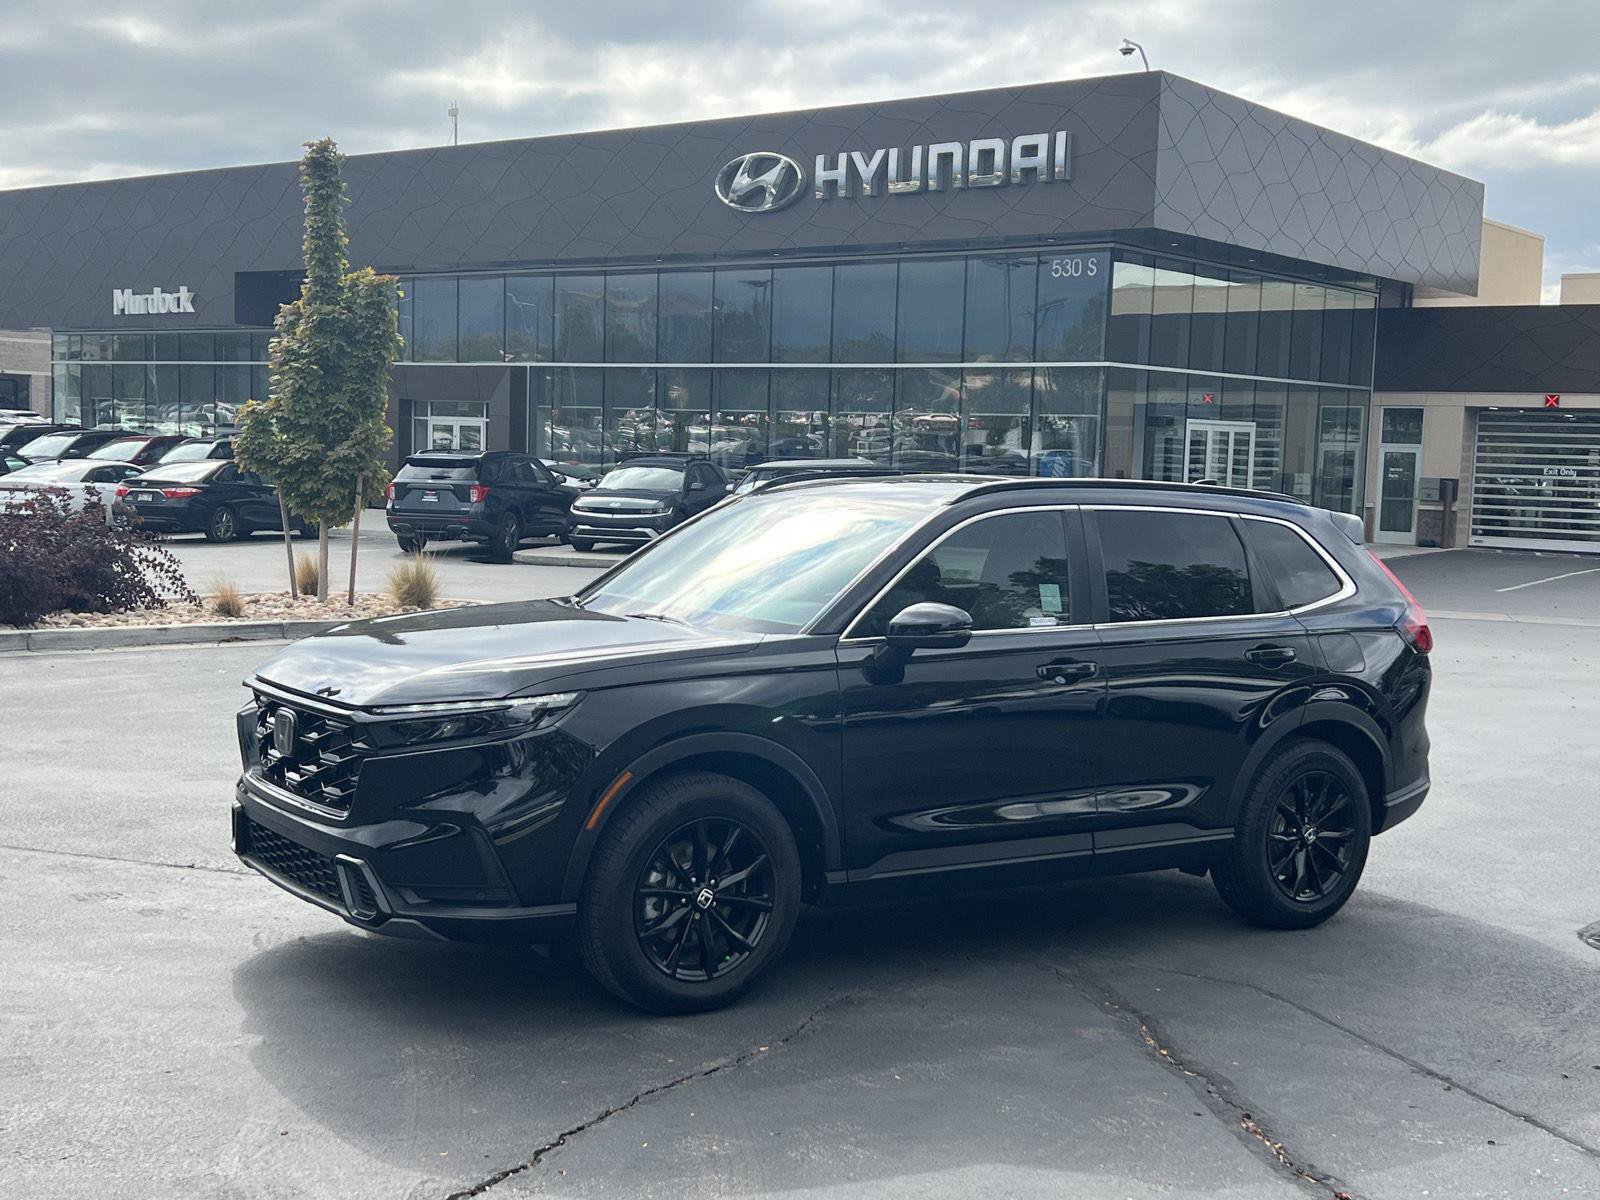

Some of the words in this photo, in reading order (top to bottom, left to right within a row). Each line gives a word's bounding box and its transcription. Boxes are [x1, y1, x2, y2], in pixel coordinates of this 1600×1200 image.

[814, 130, 1072, 199] HYUNDAI
[1051, 259, 1082, 277] 530
[1087, 258, 1097, 276] S
[113, 286, 195, 315] Murdock
[1560, 468, 1577, 477] Only
